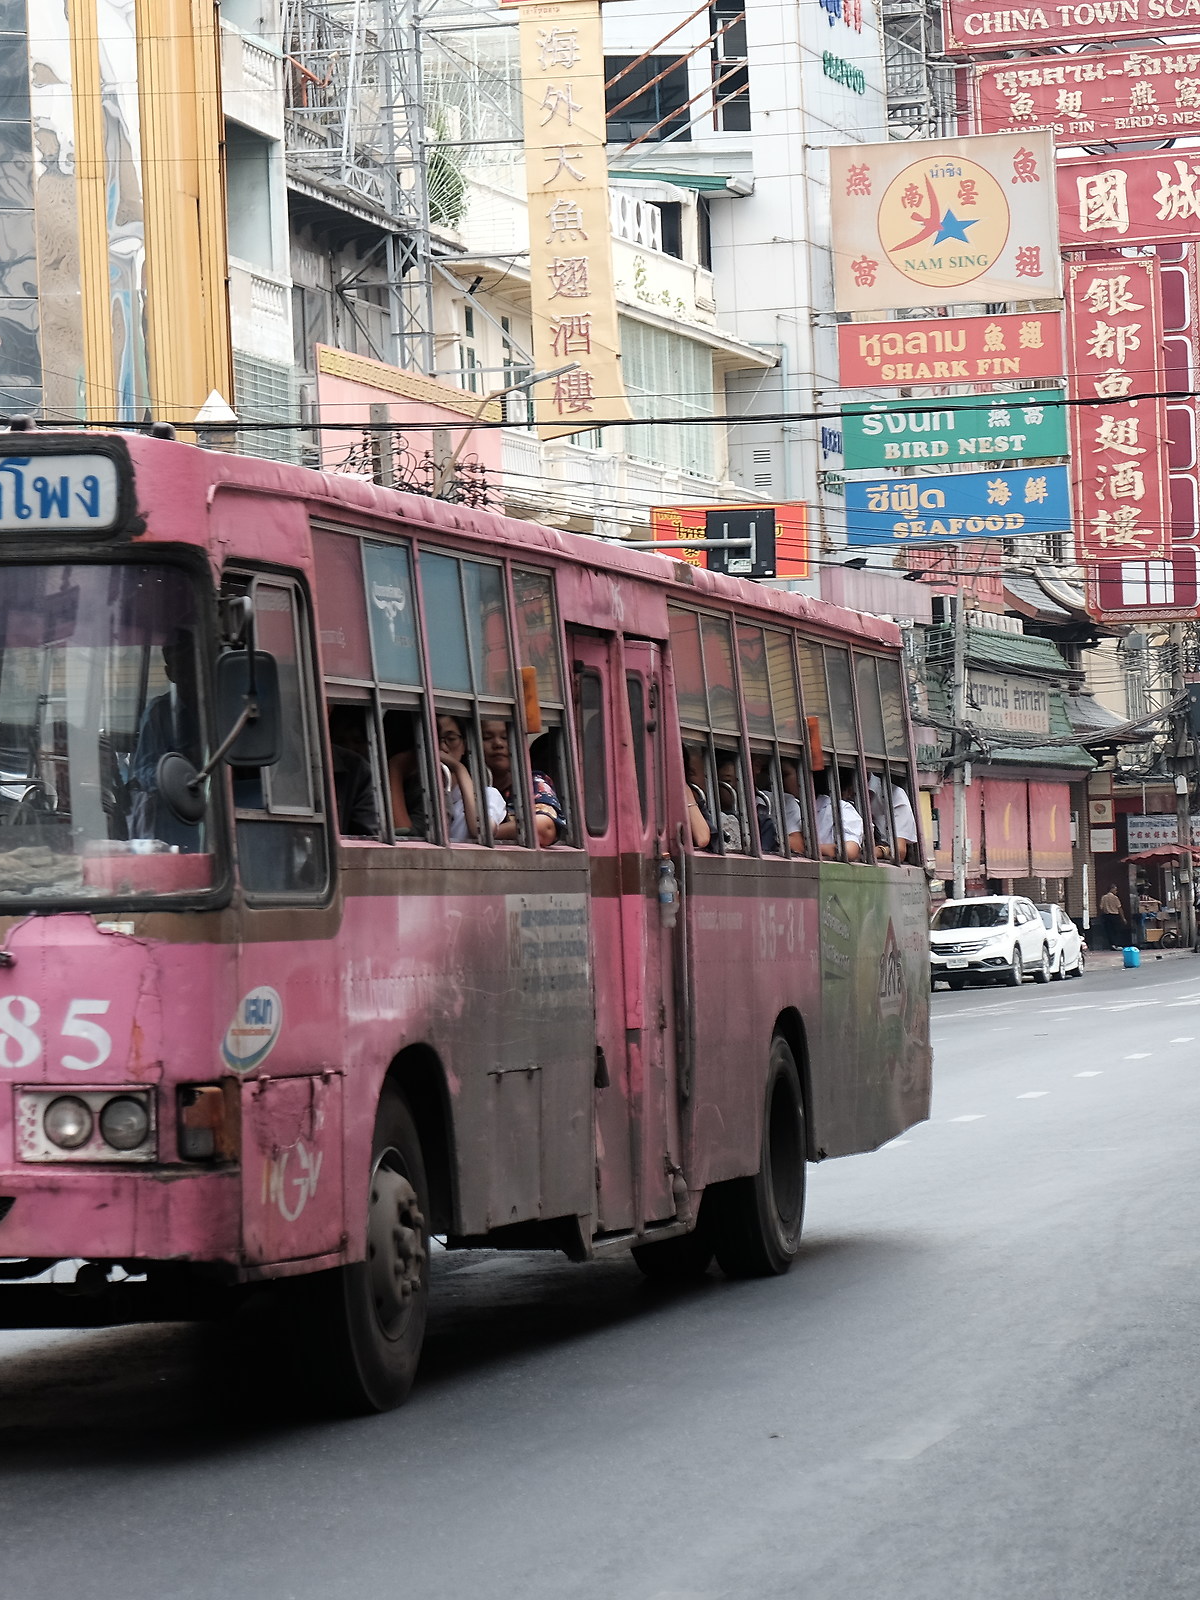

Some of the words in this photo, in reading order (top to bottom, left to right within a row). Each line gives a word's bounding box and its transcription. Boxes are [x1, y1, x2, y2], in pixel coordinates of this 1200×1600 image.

[963, 8, 1049, 36] CHINA
[1056, 0, 1139, 27] TOWN
[1069, 121, 1095, 134] FIN
[1115, 114, 1168, 129] BIRD'S
[536, 27, 596, 415] 海外天魚翅酒樓
[904, 259, 942, 271] NAM
[949, 255, 988, 268] SING
[859, 330, 966, 366] หูฉลาม
[983, 321, 1044, 352] 魚翅
[881, 360, 969, 380] SHARK
[977, 357, 1020, 375] FIN
[1081, 274, 1154, 549] 銀都魚翅酒樓
[884, 440, 950, 459] BIRD
[958, 435, 1027, 454] NEST
[987, 476, 1048, 505] 海鮮
[893, 513, 1025, 538] SEAFOOD
